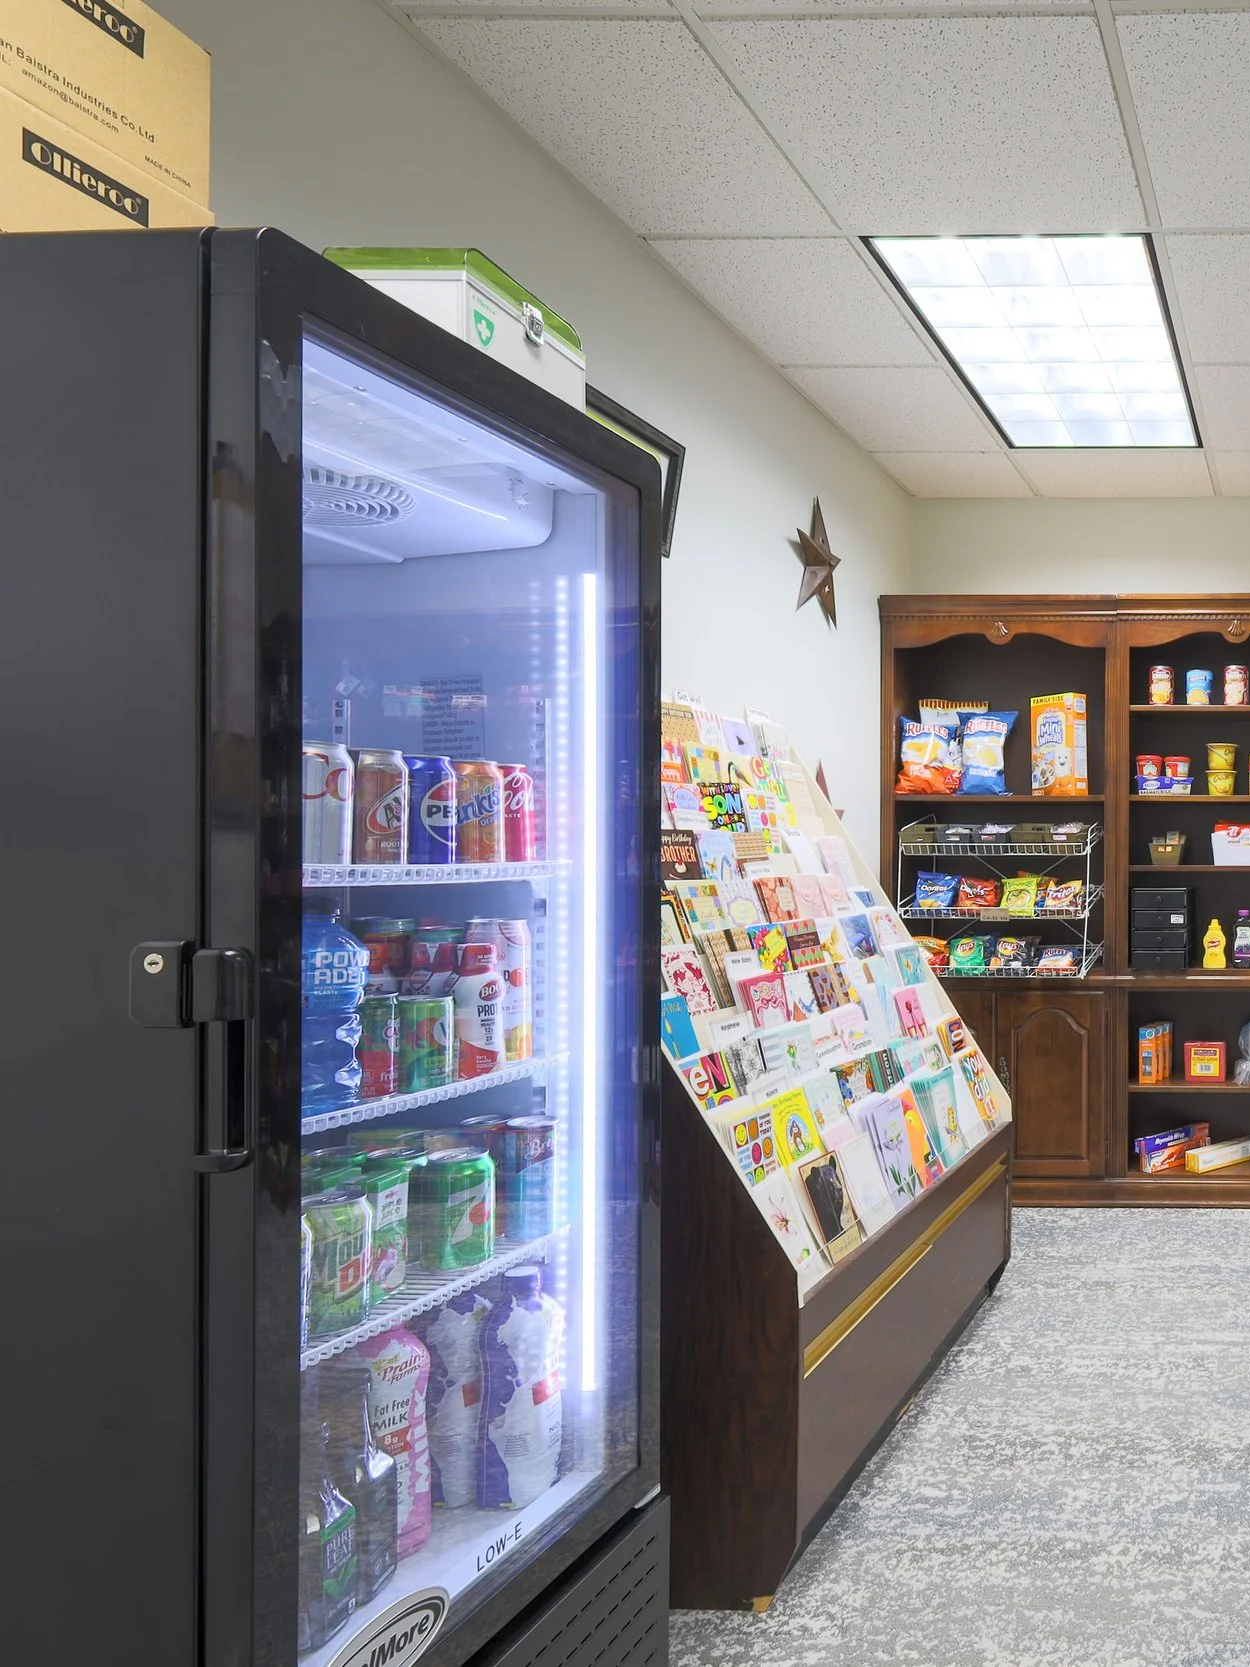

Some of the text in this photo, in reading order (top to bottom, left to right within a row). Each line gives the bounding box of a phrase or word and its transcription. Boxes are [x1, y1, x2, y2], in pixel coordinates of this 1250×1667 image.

[16, 46, 60, 82] Baistra
[62, 76, 118, 120] Industries
[22, 67, 119, 134] amazon@baistra.com
[30, 141, 140, 215] Ollieroo
[144, 155, 192, 188] MADE IN CHINA
[906, 722, 949, 739] RUFFLES
[964, 718, 1008, 734] RUFFLES
[1040, 720, 1061, 737] Mini
[703, 793, 741, 821] SON
[920, 883, 949, 895] Doritos
[373, 1411, 408, 1432] MILK
[374, 1398, 410, 1418] Fat Free
[384, 1434, 398, 1445] 8g
[326, 1523, 354, 1556] PURE
[327, 1537, 353, 1569] LEAF
[476, 1521, 522, 1573] LOW-E
